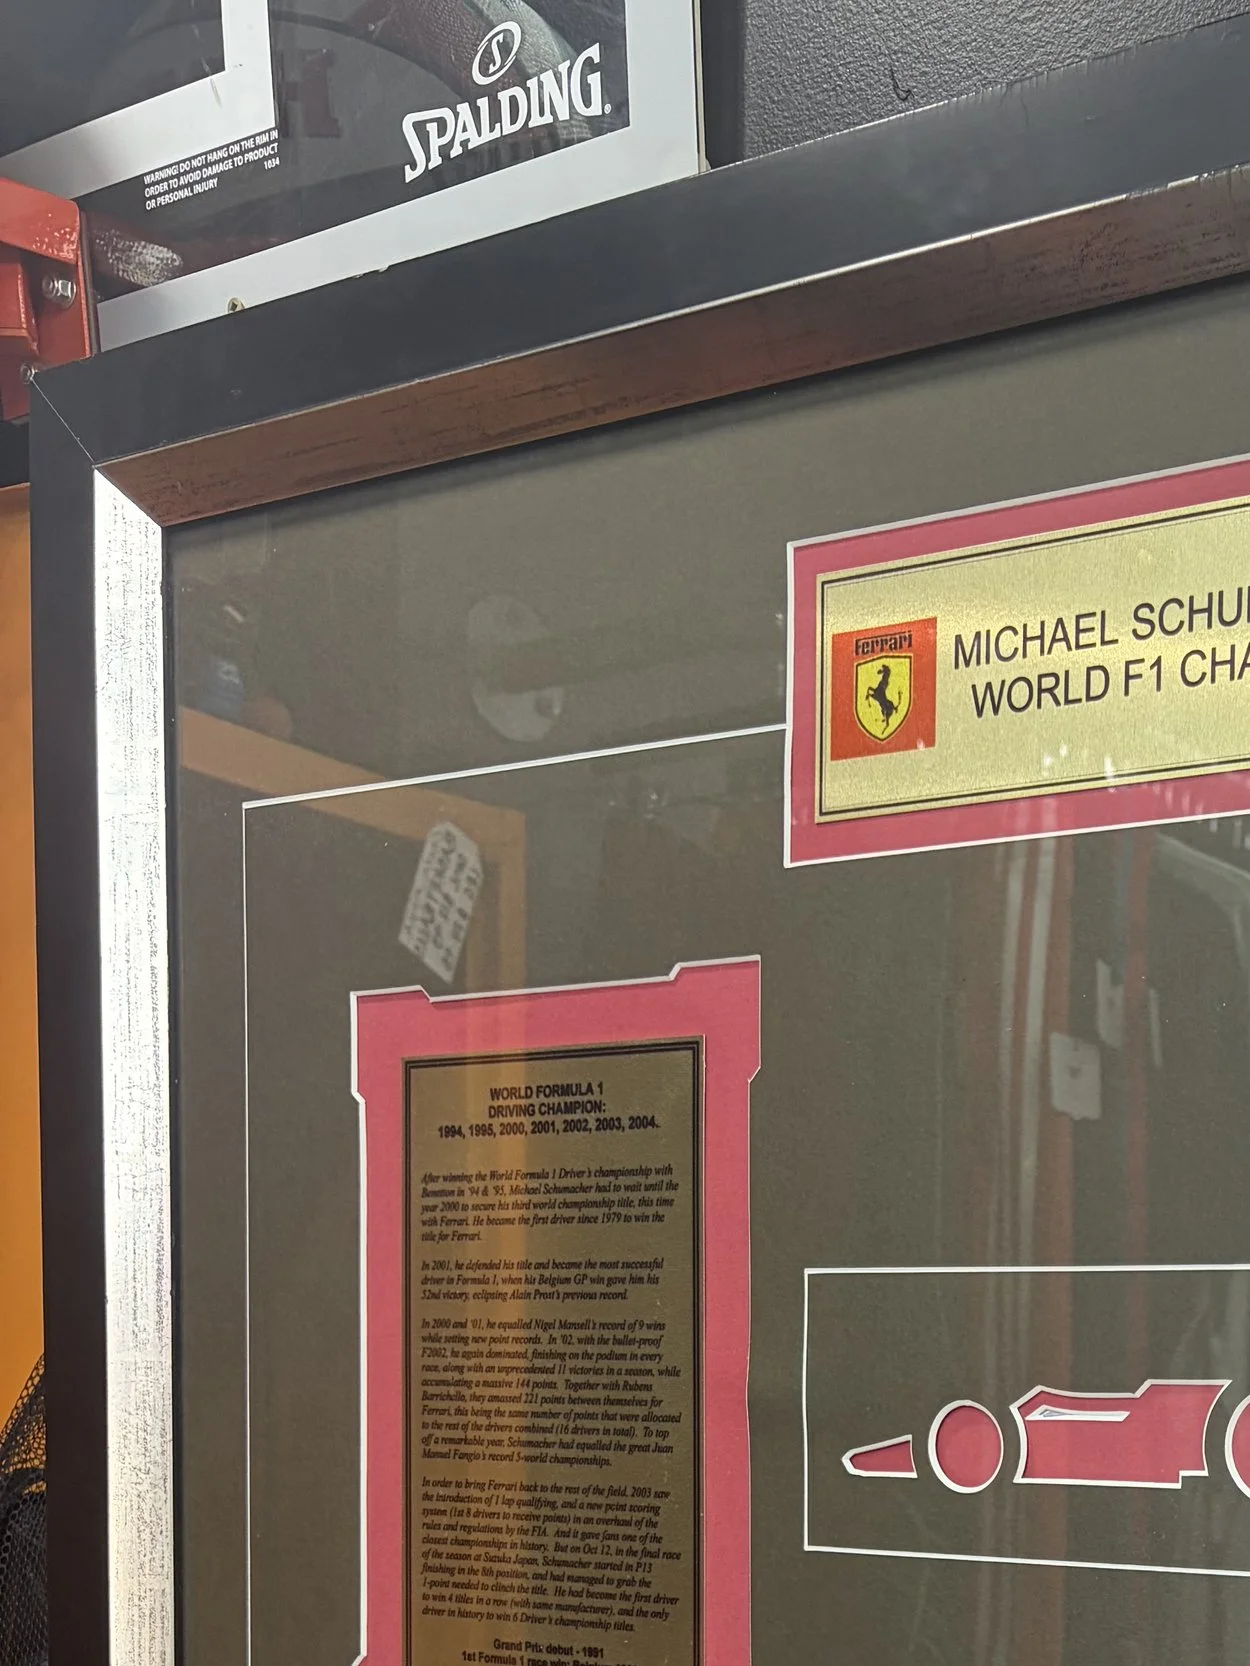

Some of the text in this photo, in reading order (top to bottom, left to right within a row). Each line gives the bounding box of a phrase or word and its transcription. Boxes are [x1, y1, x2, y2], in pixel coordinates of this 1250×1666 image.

[402, 42, 601, 184] SPALDING
[144, 130, 278, 184] WARNING! DO NOT HANG ON THE RIM IN
[144, 142, 278, 198] ORDER TO AVOID DAMAGE TO PRODUCT
[264, 156, 280, 170] 1034
[146, 178, 218, 210] OR PERSONAL INJURY
[854, 630, 913, 657] Ferrari
[954, 610, 1120, 670] MICHAEL
[971, 664, 1110, 718] WORLD
[1124, 656, 1163, 697] F1
[489, 1085, 533, 1101] WORLD
[535, 1081, 594, 1099] FORMULA
[487, 1102, 536, 1119] DRIVING
[461, 1650, 476, 1662] 1st
[478, 1651, 517, 1666] Formula
[492, 1638, 604, 1658] Grand Prix debut 1991
